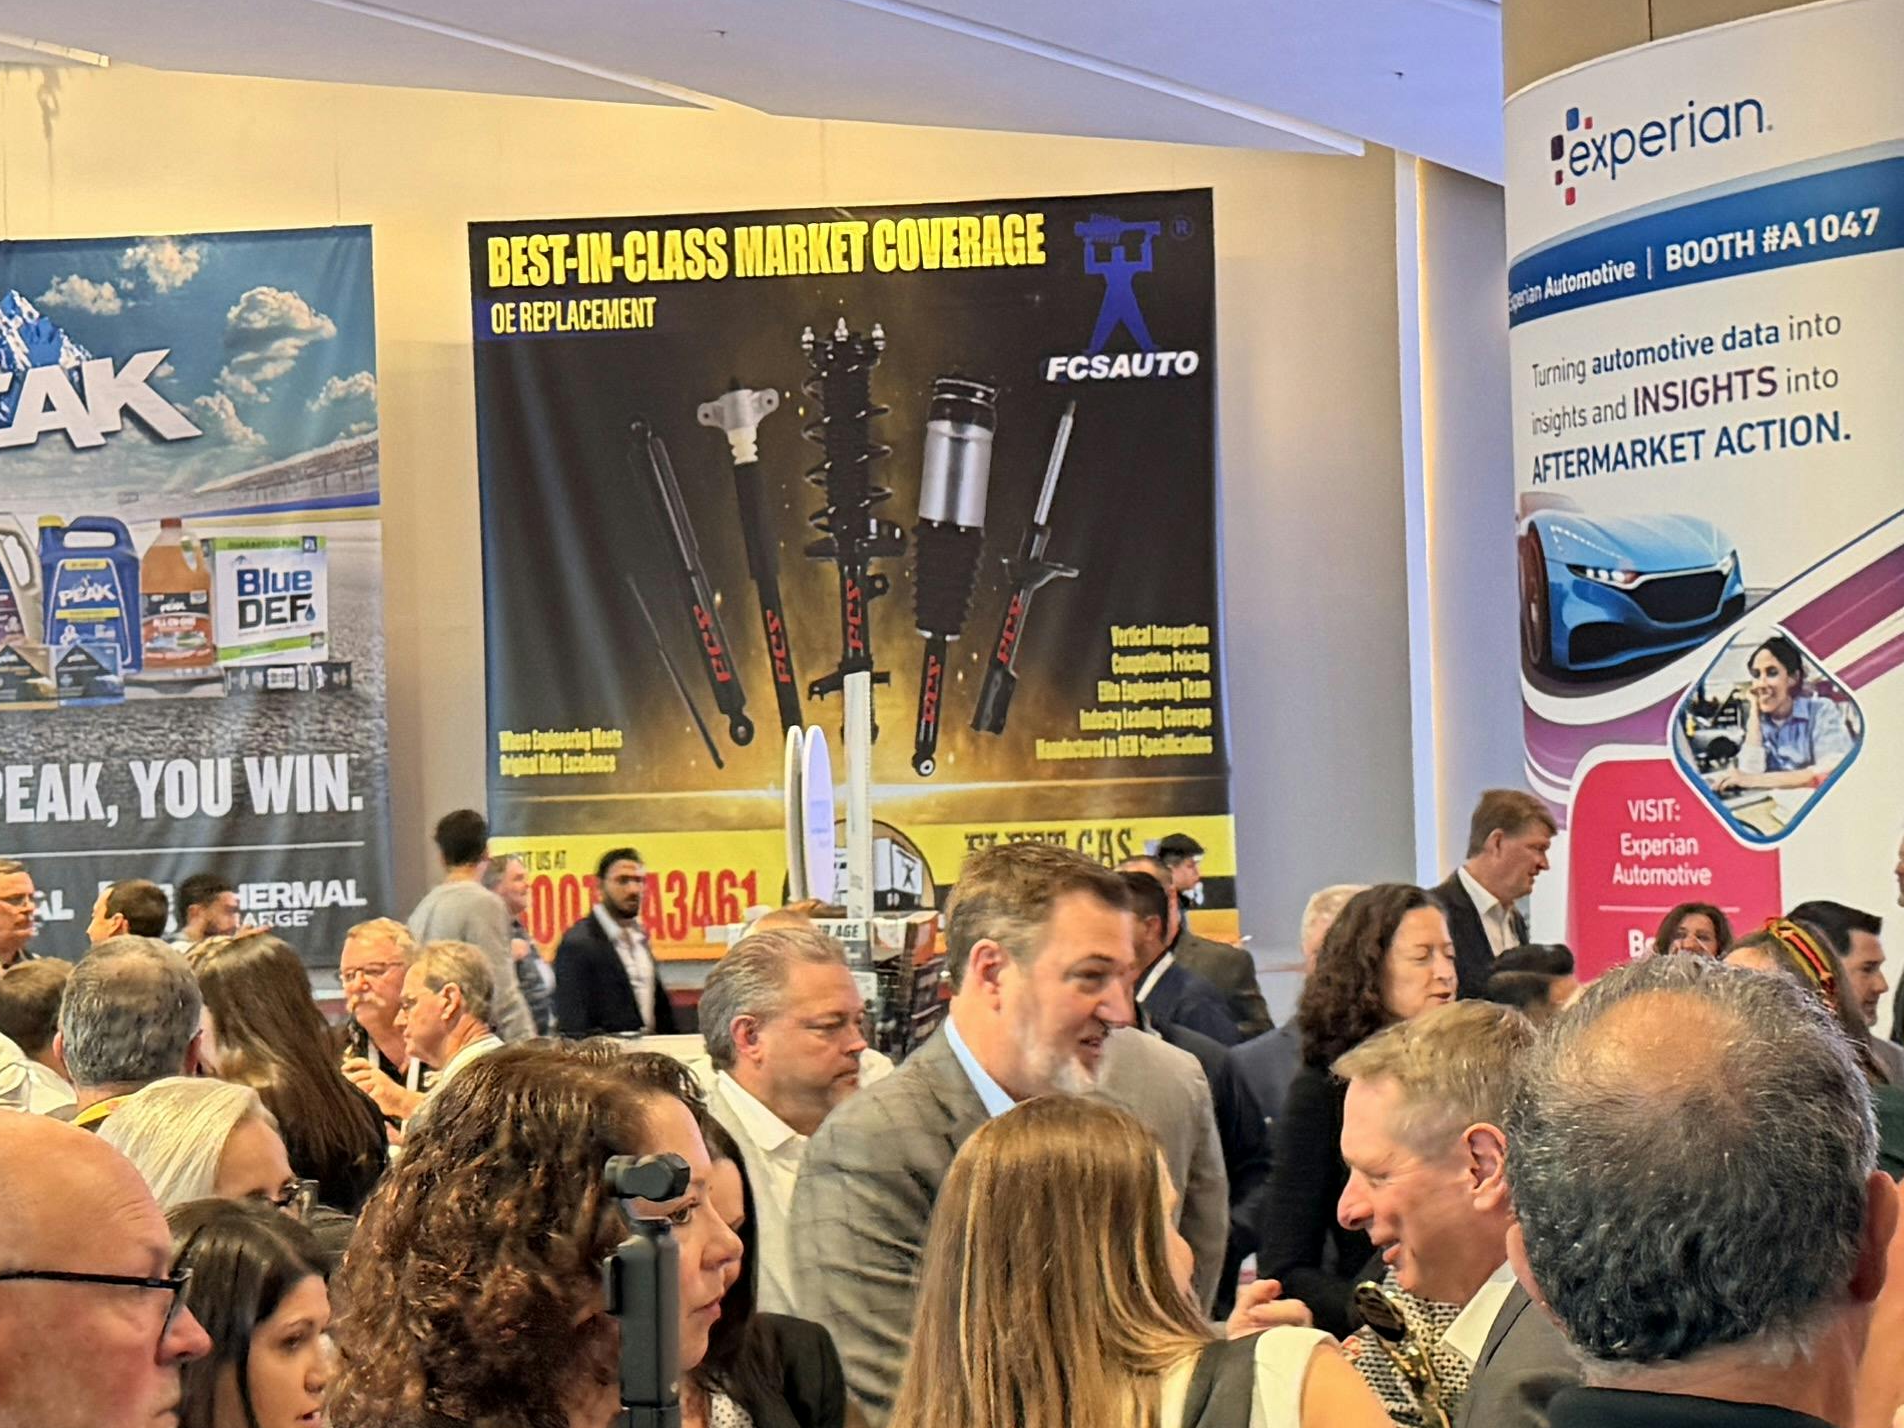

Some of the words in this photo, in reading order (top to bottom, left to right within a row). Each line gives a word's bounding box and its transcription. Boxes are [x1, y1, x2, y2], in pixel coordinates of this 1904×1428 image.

[487, 228, 728, 289] BEST-IN-CLASS
[734, 220, 872, 278] MARKET
[873, 213, 1046, 273] COVERAGE
[1545, 260, 1635, 300] Automotive
[1665, 228, 1755, 272] BOOTH
[1761, 207, 1881, 253] #A1047
[490, 302, 518, 334] OE
[519, 297, 657, 333] REPLACEMENT
[1046, 350, 1199, 382] FCSAUTO
[1532, 357, 1587, 389] Turning
[1592, 333, 1714, 375] automotive
[1721, 323, 1780, 352] data
[1788, 313, 1841, 341] into
[1531, 404, 1587, 438] insights
[1592, 396, 1626, 425] and
[1633, 365, 1778, 417] INSIGHTS
[1786, 366, 1839, 394] into
[1532, 429, 1706, 485] AFTERMARKET
[1714, 410, 1852, 458] ACTION.
[58, 583, 118, 608] PEAK
[237, 567, 313, 597] Blue
[238, 594, 313, 630] DEF
[130, 756, 232, 820] YOU
[244, 753, 364, 813] WIN.
[1627, 798, 1681, 823] VISIT:
[1620, 831, 1700, 861] Experian
[1612, 861, 1713, 886] Automotive
[234, 878, 367, 911] HERMAL
